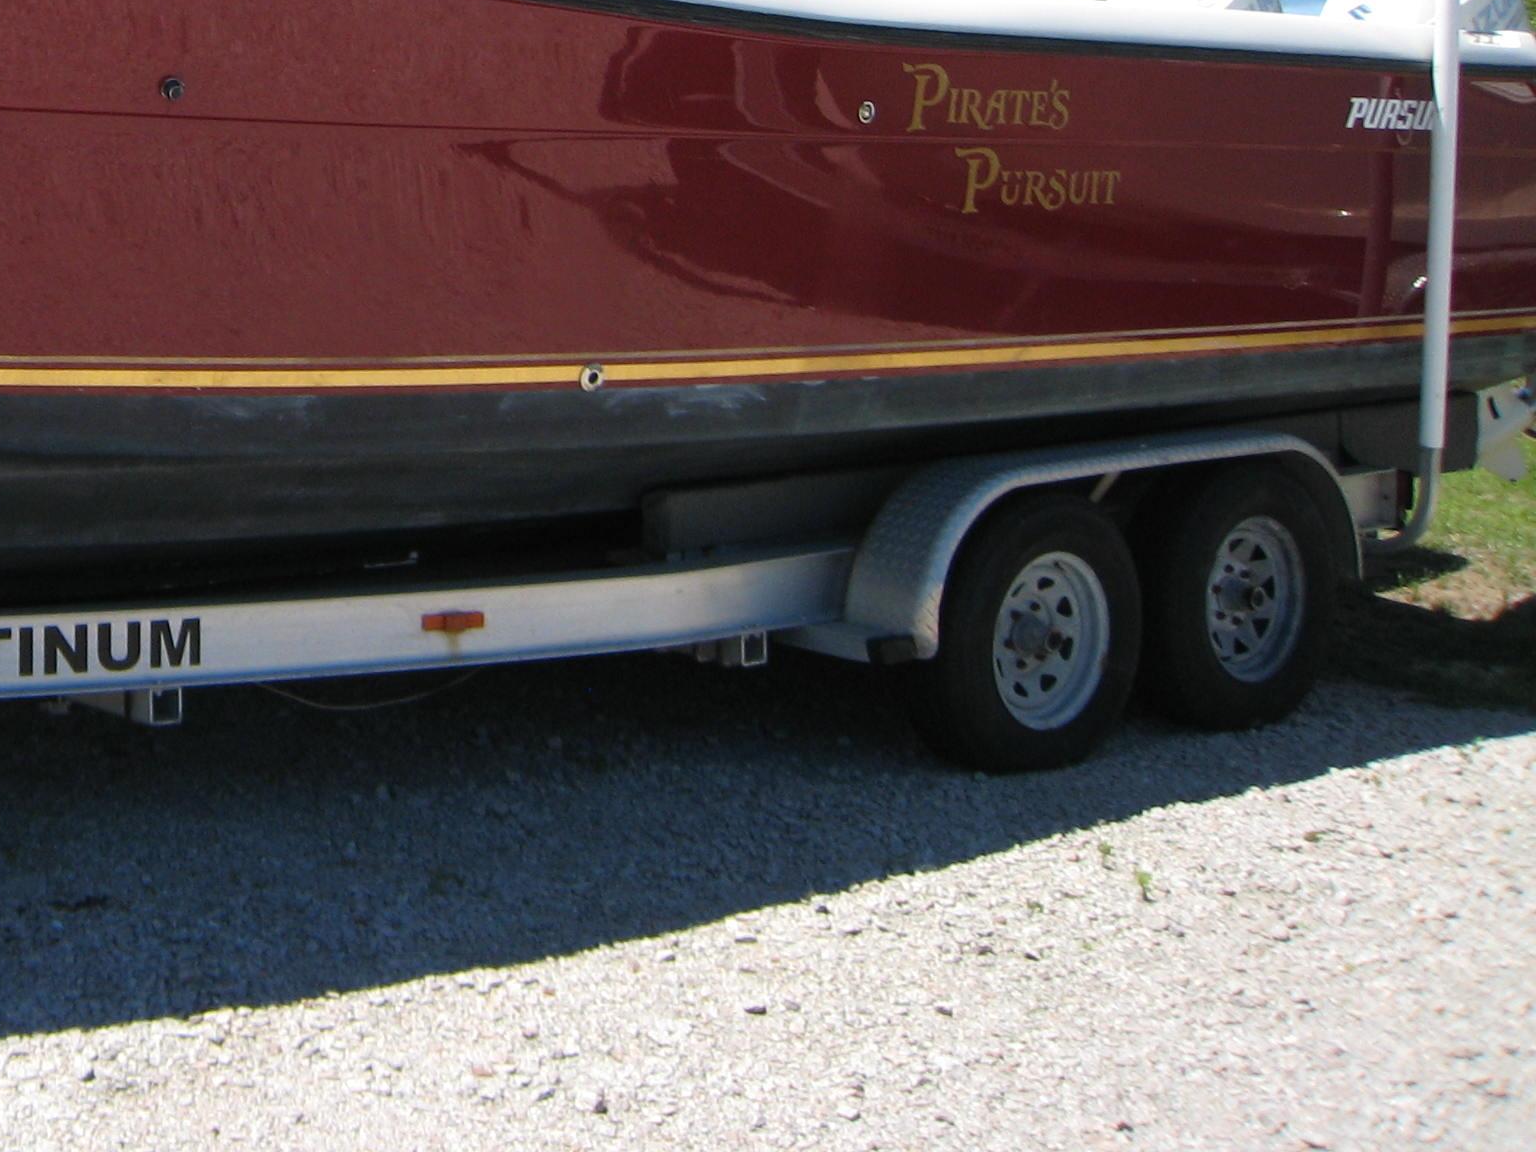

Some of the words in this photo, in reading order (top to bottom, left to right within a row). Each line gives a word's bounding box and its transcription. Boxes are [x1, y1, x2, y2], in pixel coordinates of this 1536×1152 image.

[902, 62, 1070, 133] PIRATE'S
[1345, 97, 1433, 131] PURSU
[954, 147, 1121, 214] PURSUIT
